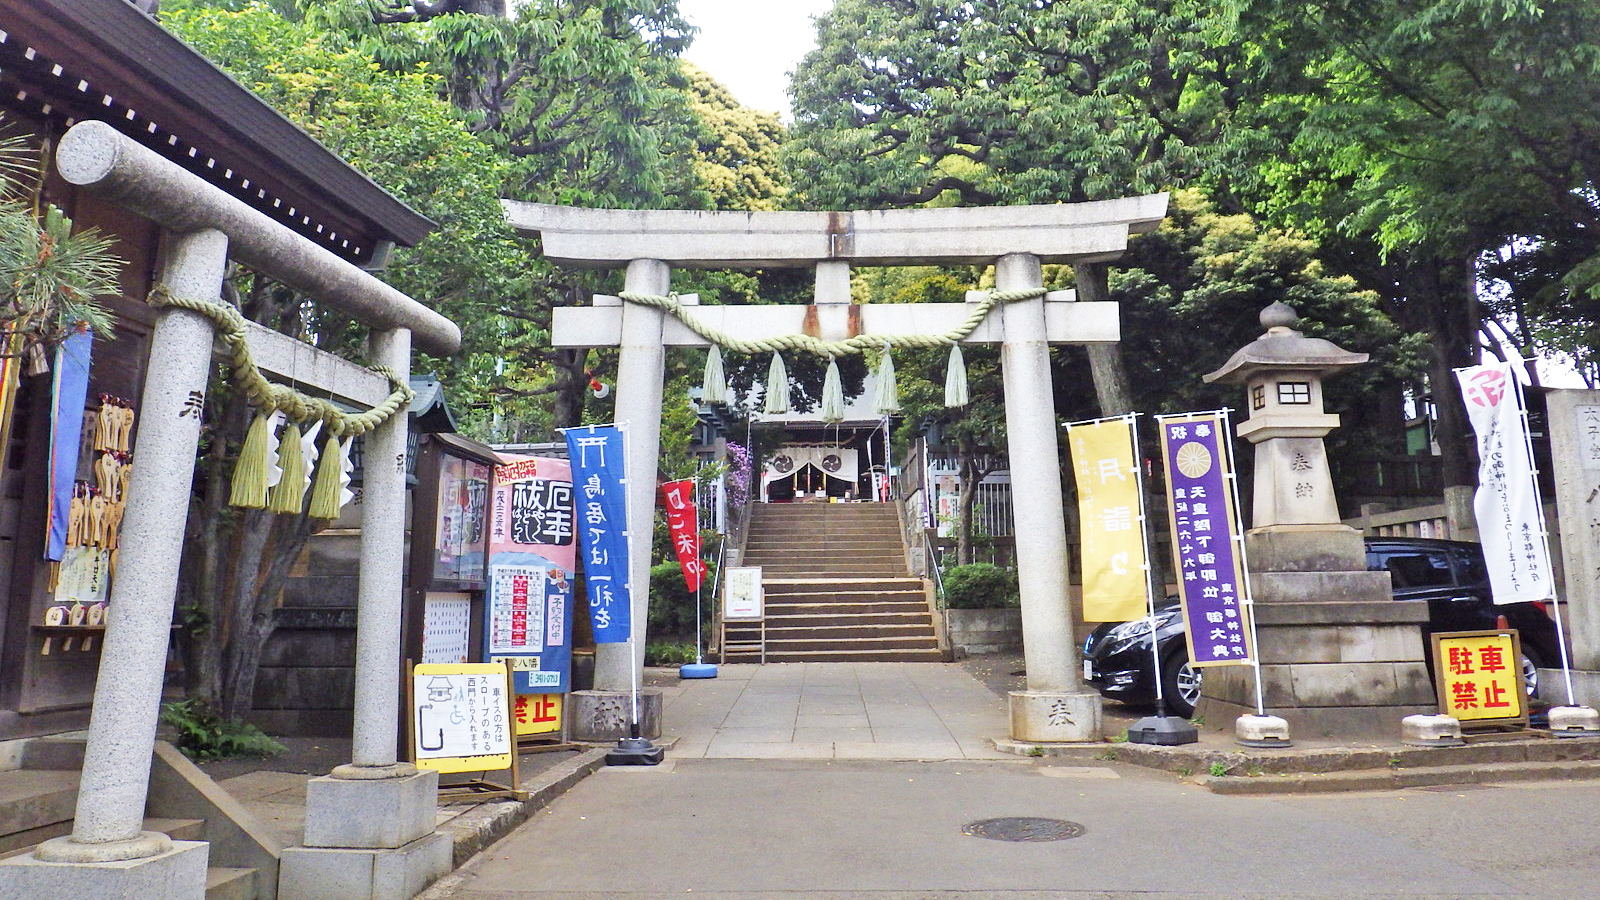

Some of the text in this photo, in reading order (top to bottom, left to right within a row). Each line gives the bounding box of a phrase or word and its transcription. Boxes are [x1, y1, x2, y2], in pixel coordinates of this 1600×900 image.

[1448, 645, 1506, 675] 駐車
[467, 677, 478, 751] 西門から入れます
[480, 676, 491, 751] スロープのある
[492, 687, 503, 743] 車イスの方は
[1452, 680, 1510, 710] 禁止
